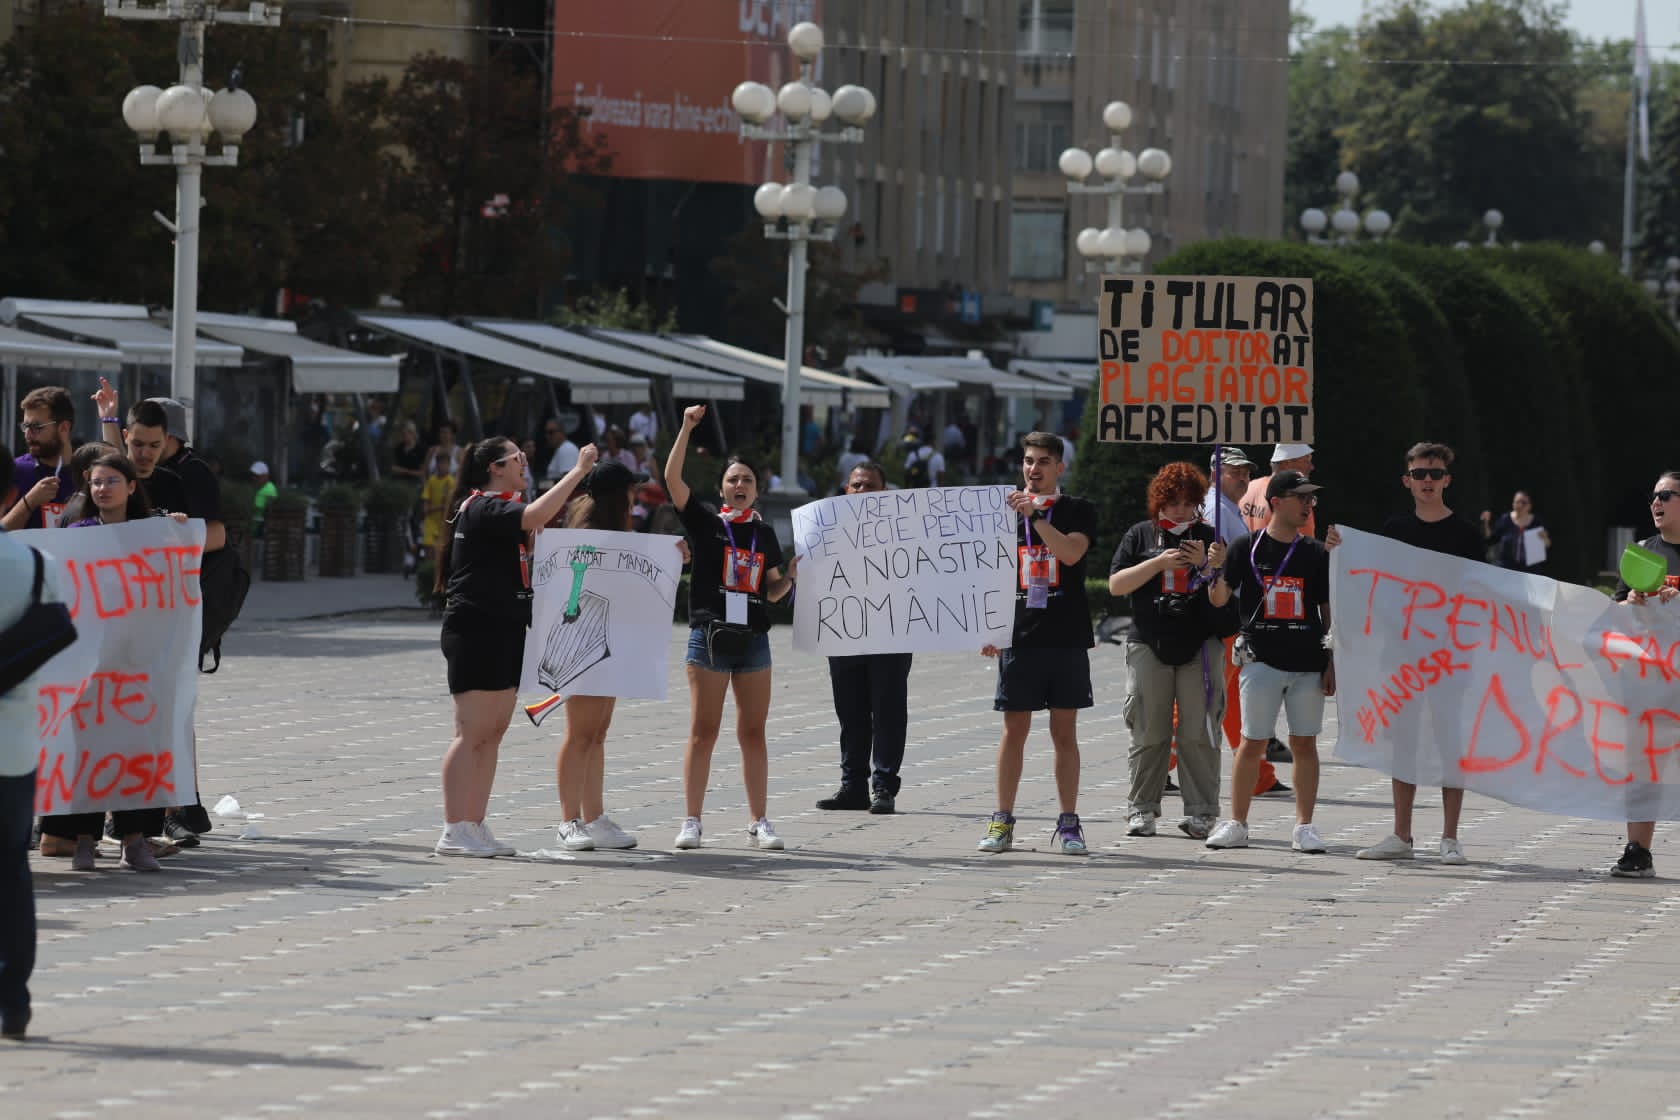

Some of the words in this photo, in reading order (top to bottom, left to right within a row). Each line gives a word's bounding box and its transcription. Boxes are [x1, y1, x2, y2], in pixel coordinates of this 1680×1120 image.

[1101, 329, 1139, 362] DE
[1161, 329, 1309, 366] DOCTORAT
[799, 500, 838, 527] NU
[846, 493, 917, 521] VREM
[805, 528, 841, 560] PE
[843, 516, 915, 549] VECIE
[922, 511, 1016, 538] PENTRU
[617, 551, 663, 583] MANDAT
[830, 560, 851, 592] A
[1356, 648, 1471, 744] #ANOSR
